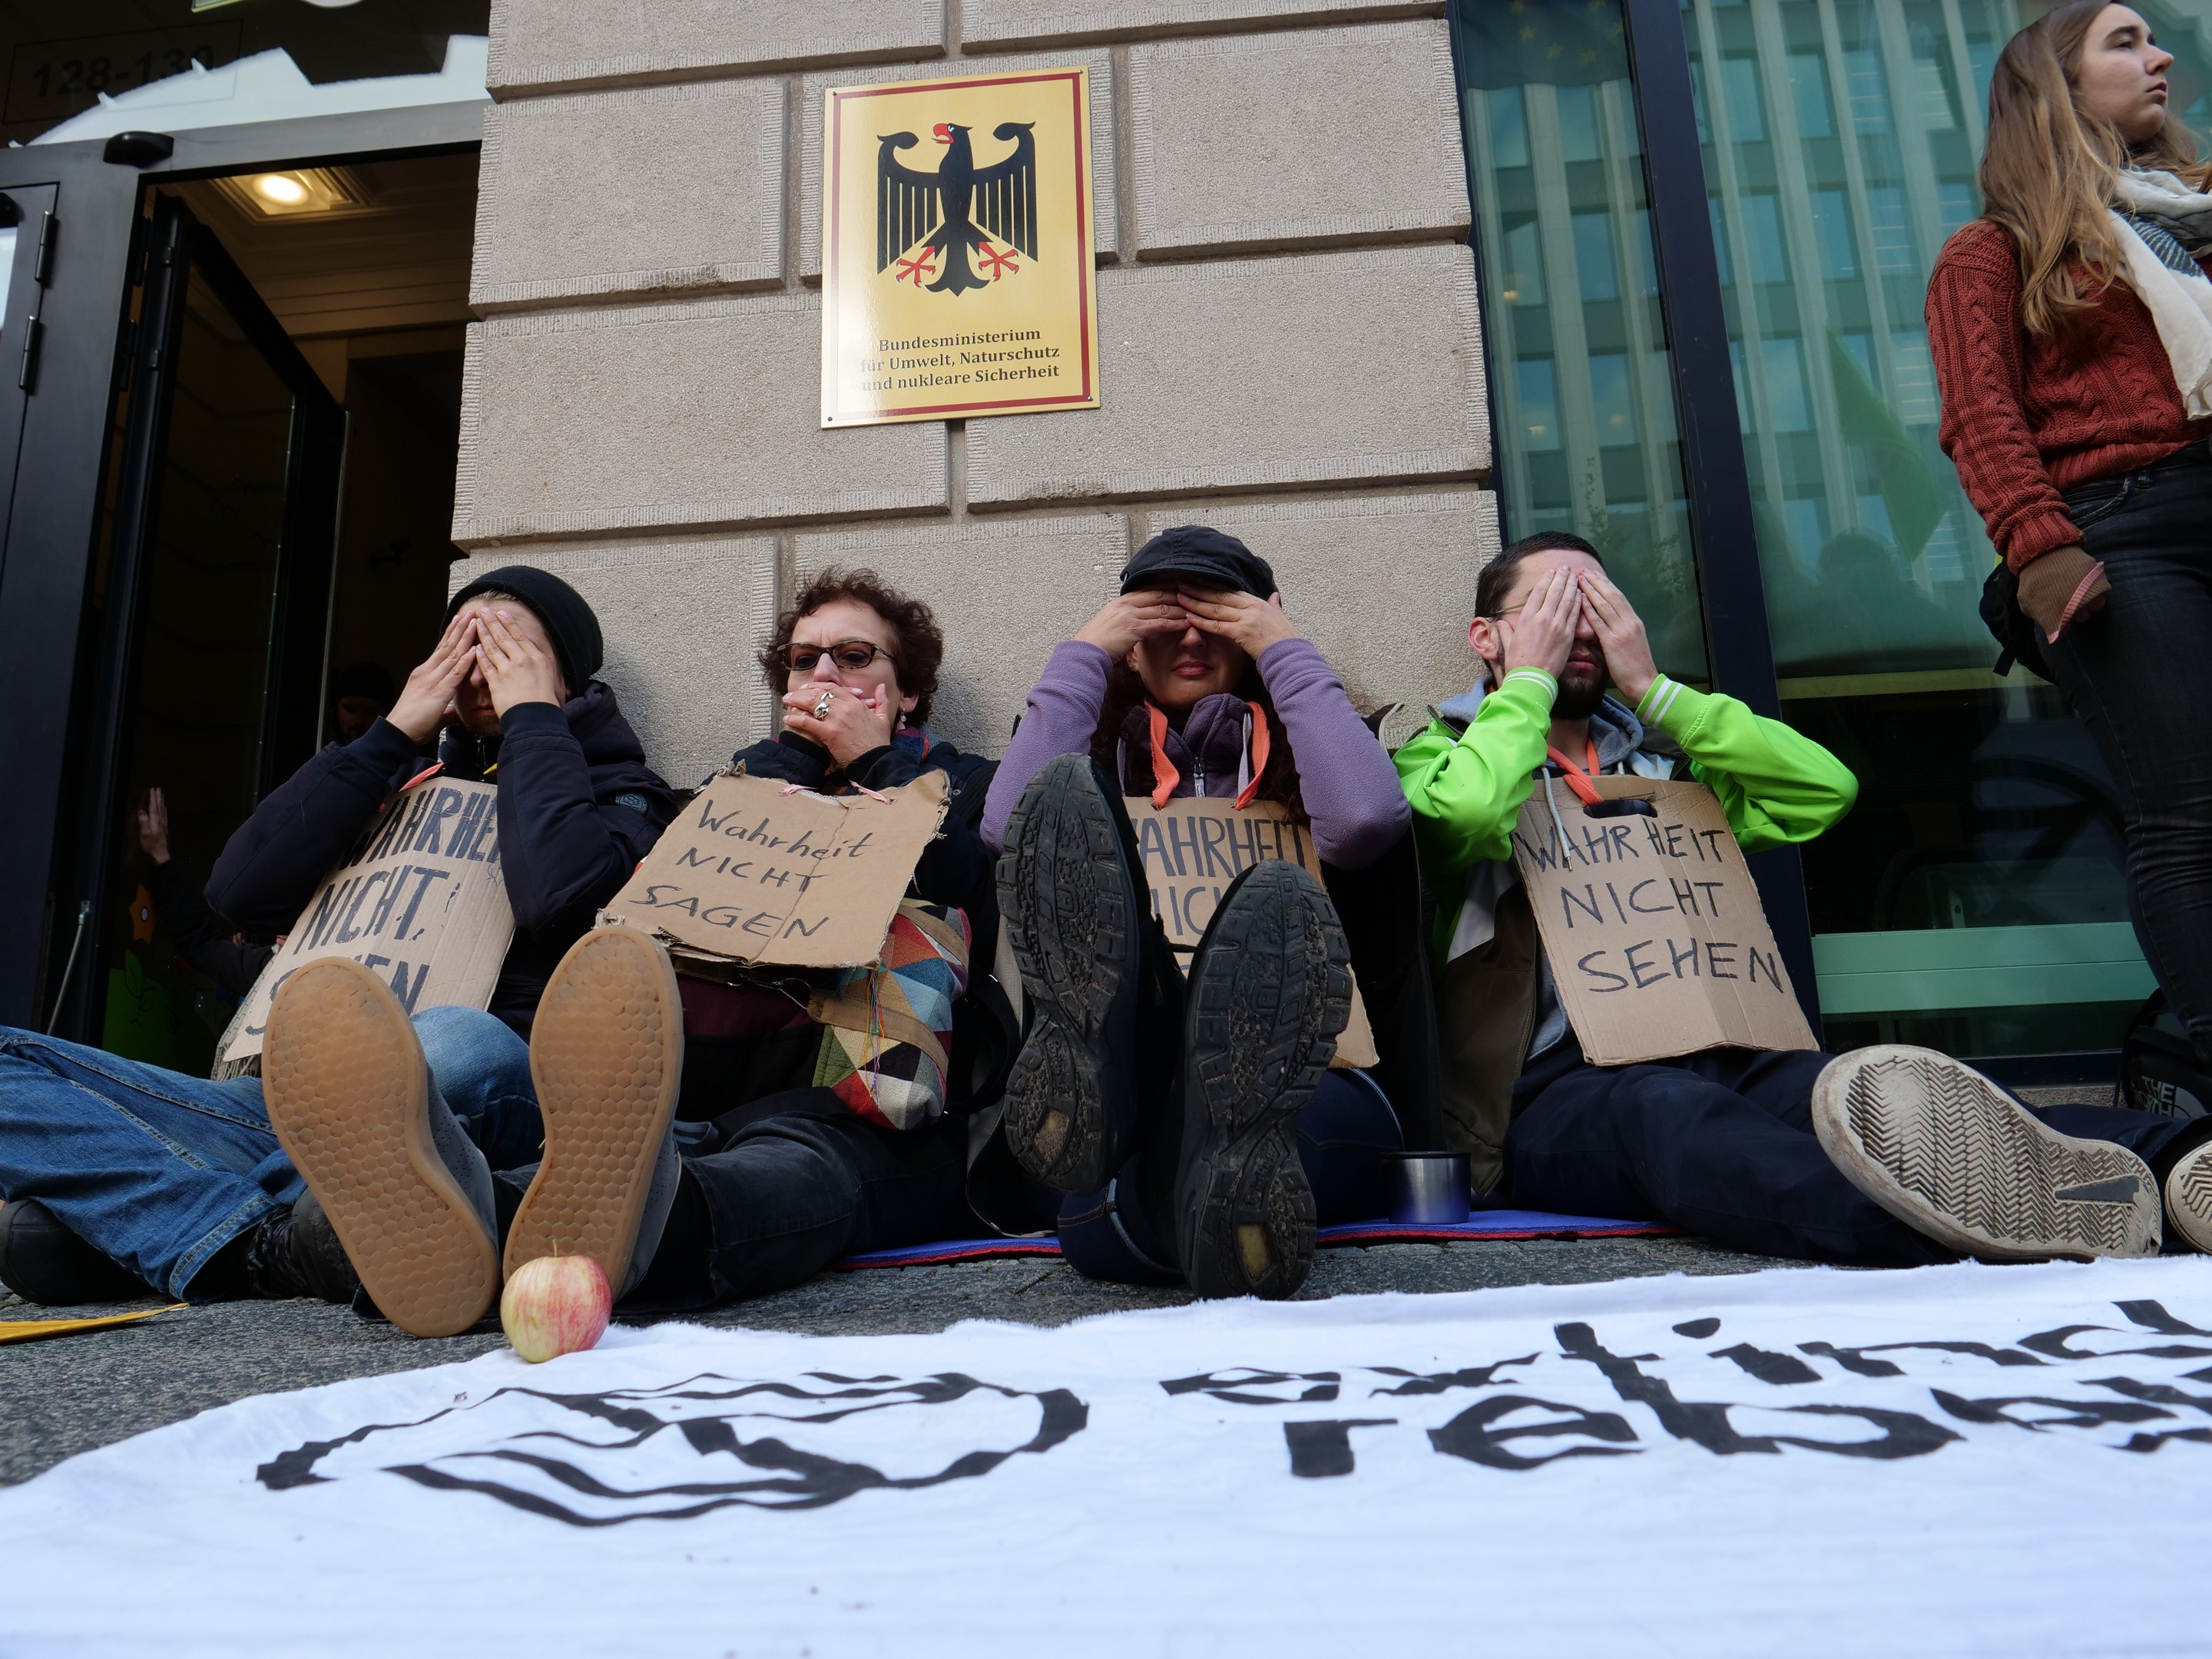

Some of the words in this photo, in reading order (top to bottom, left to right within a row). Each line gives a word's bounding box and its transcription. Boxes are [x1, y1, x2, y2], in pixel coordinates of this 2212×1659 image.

[860, 358, 885, 373] für
[889, 353, 955, 370] Umwelt,
[959, 346, 1060, 365] Naturschutz
[879, 329, 1041, 352] Bundesministerium
[862, 376, 892, 391] und
[897, 373, 971, 389] nukleare
[975, 364, 1060, 382] Sicherheit
[339, 786, 502, 870] WAHRHE
[697, 799, 873, 859] Wahrheit
[1131, 816, 1306, 878] AHRHEIT
[676, 847, 831, 892] NICHT
[293, 865, 451, 955] NICHT
[628, 885, 830, 939] SAGEN
[1561, 877, 1724, 929] NICHT
[1577, 936, 1783, 994] SEHEN
[2141, 1075, 2175, 1104] THE
